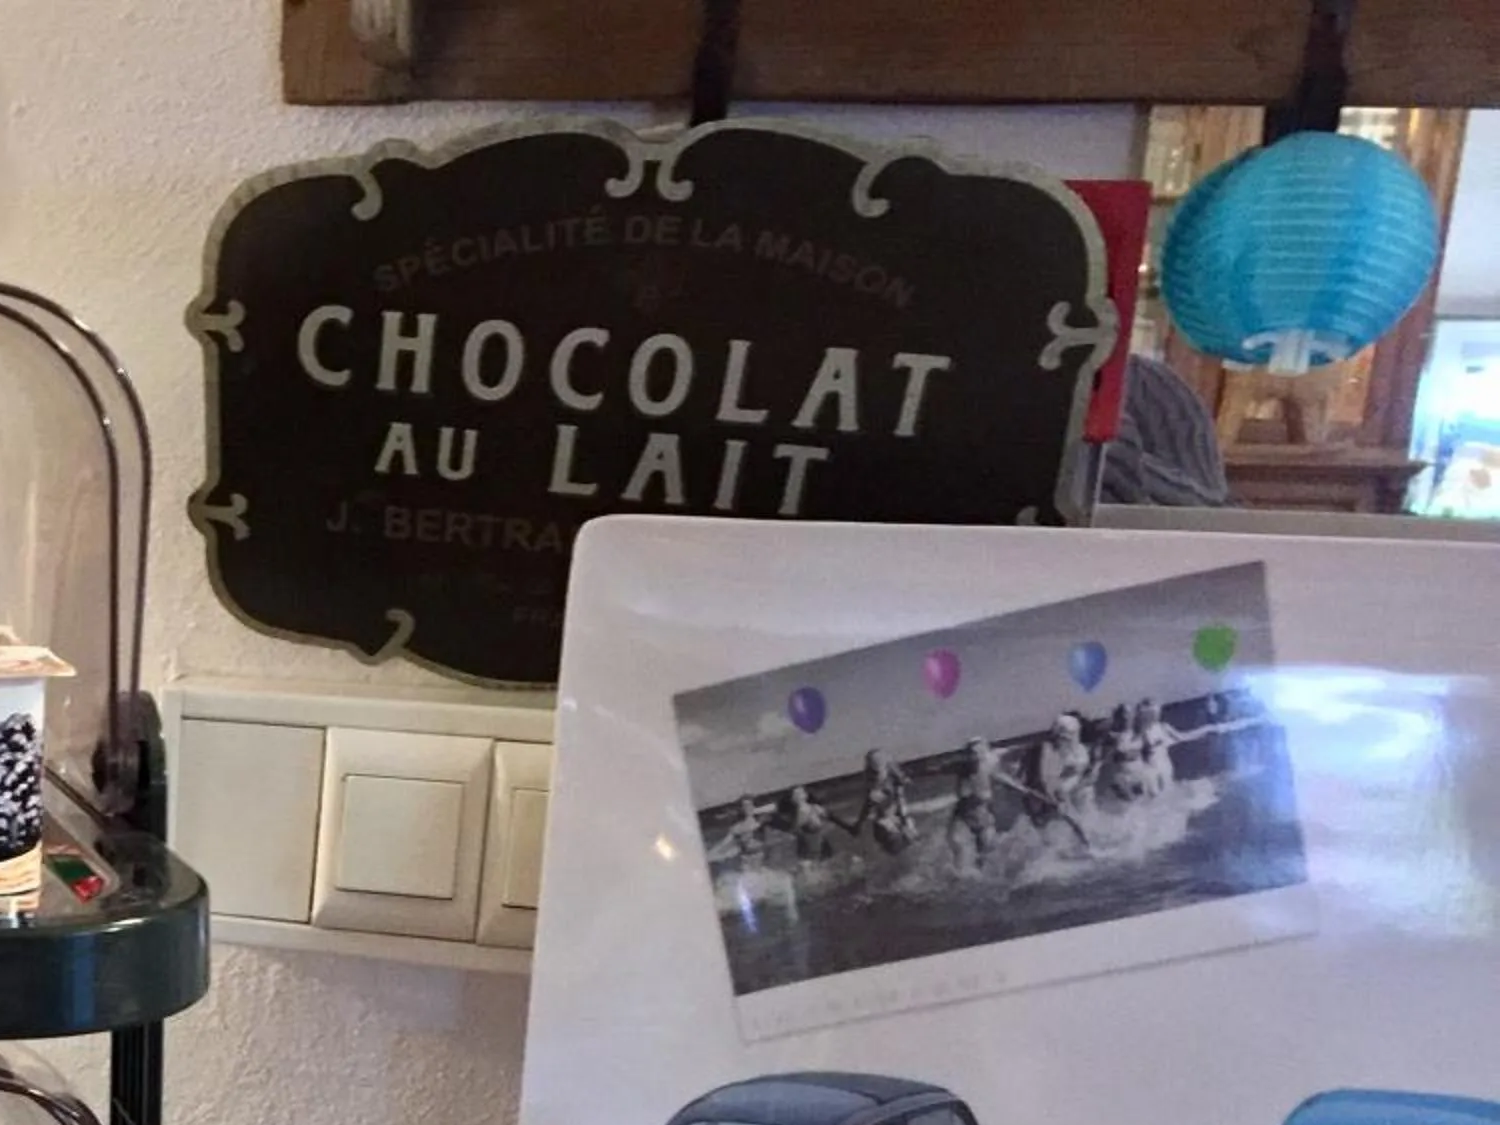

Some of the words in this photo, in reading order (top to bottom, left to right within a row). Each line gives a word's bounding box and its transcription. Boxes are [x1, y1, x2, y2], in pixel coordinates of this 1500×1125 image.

[374, 204, 611, 293] SPÉCIALITÉ
[623, 214, 682, 247] DE
[691, 216, 744, 253] LA
[755, 229, 916, 308] MAISON
[298, 303, 953, 438] CHOCOLAT
[374, 421, 478, 482] AU
[547, 424, 829, 516] LAIT
[383, 504, 568, 554] BERTRA
